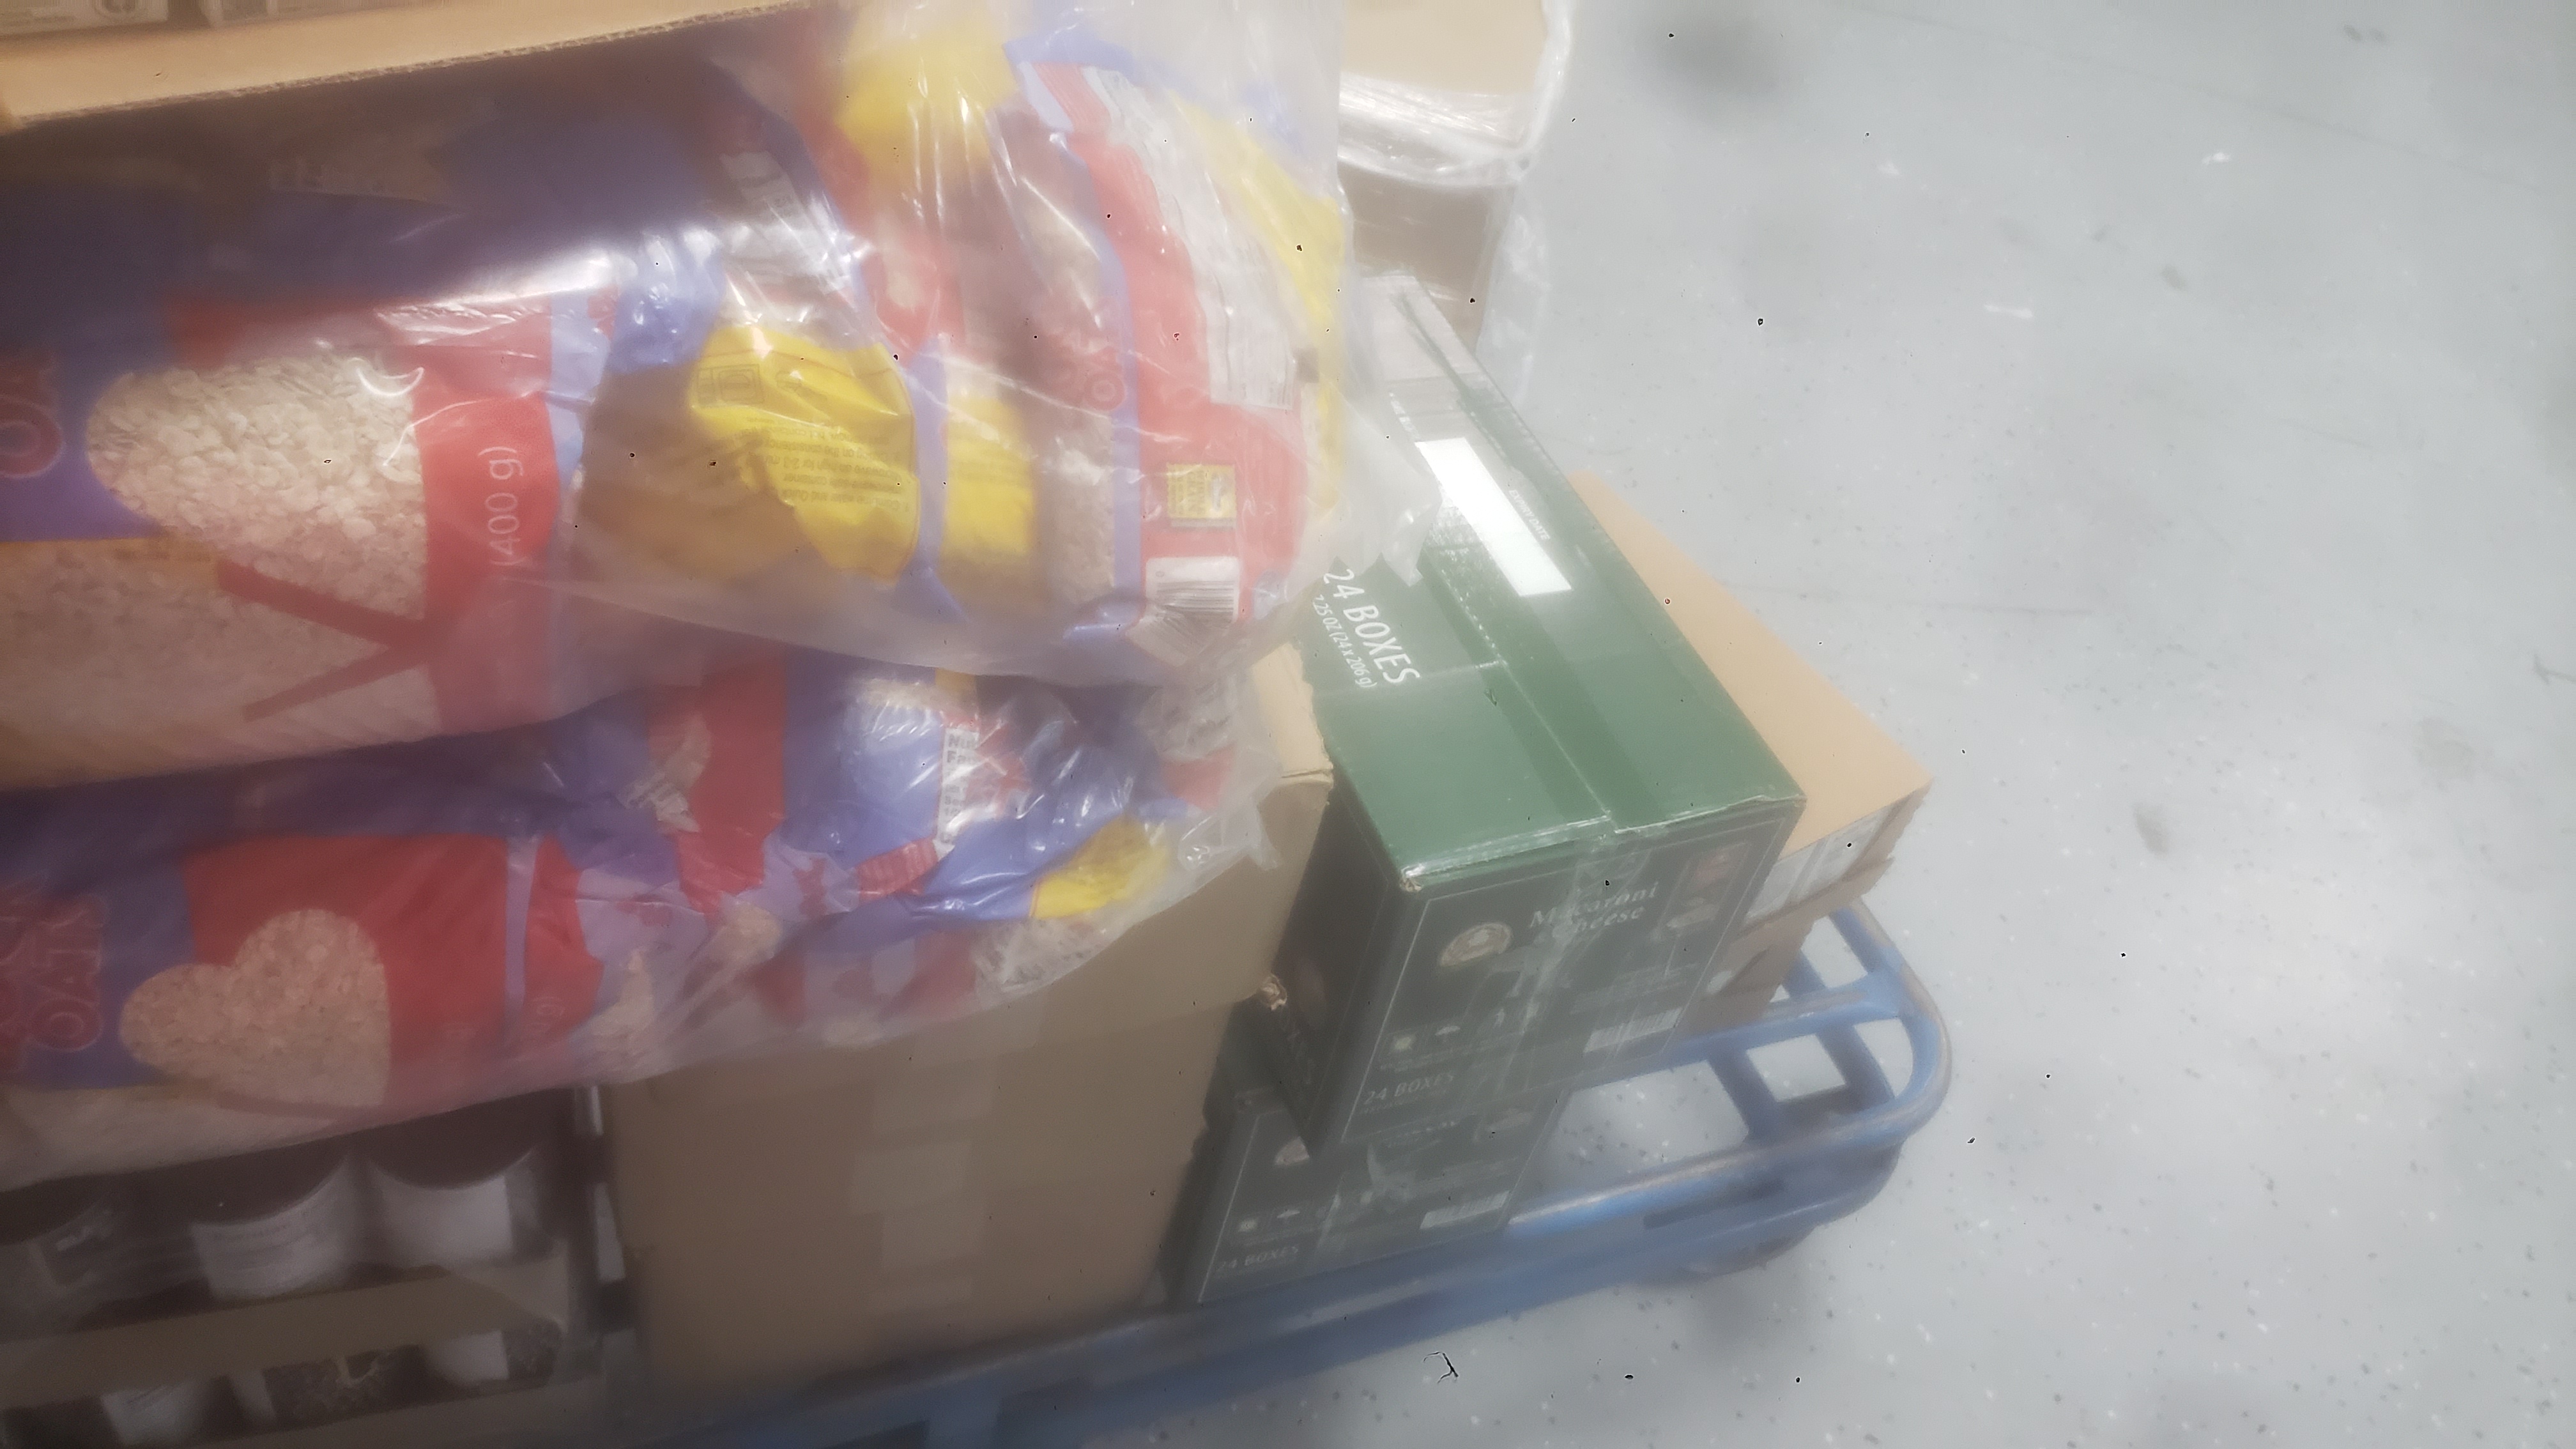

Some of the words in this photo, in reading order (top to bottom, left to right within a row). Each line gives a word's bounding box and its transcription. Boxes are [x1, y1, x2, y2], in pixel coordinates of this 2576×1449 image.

[478, 446, 524, 480] g)
[484, 493, 528, 566] (400
[1508, 489, 1535, 516] EXPIRY
[1529, 519, 1551, 540] DATE
[1324, 569, 1365, 599] 24
[1322, 617, 1342, 632] OZ
[1329, 632, 1353, 648] (24
[1343, 605, 1421, 684] BOXES
[1346, 652, 1370, 676] 206
[1355, 677, 1378, 688] g)
